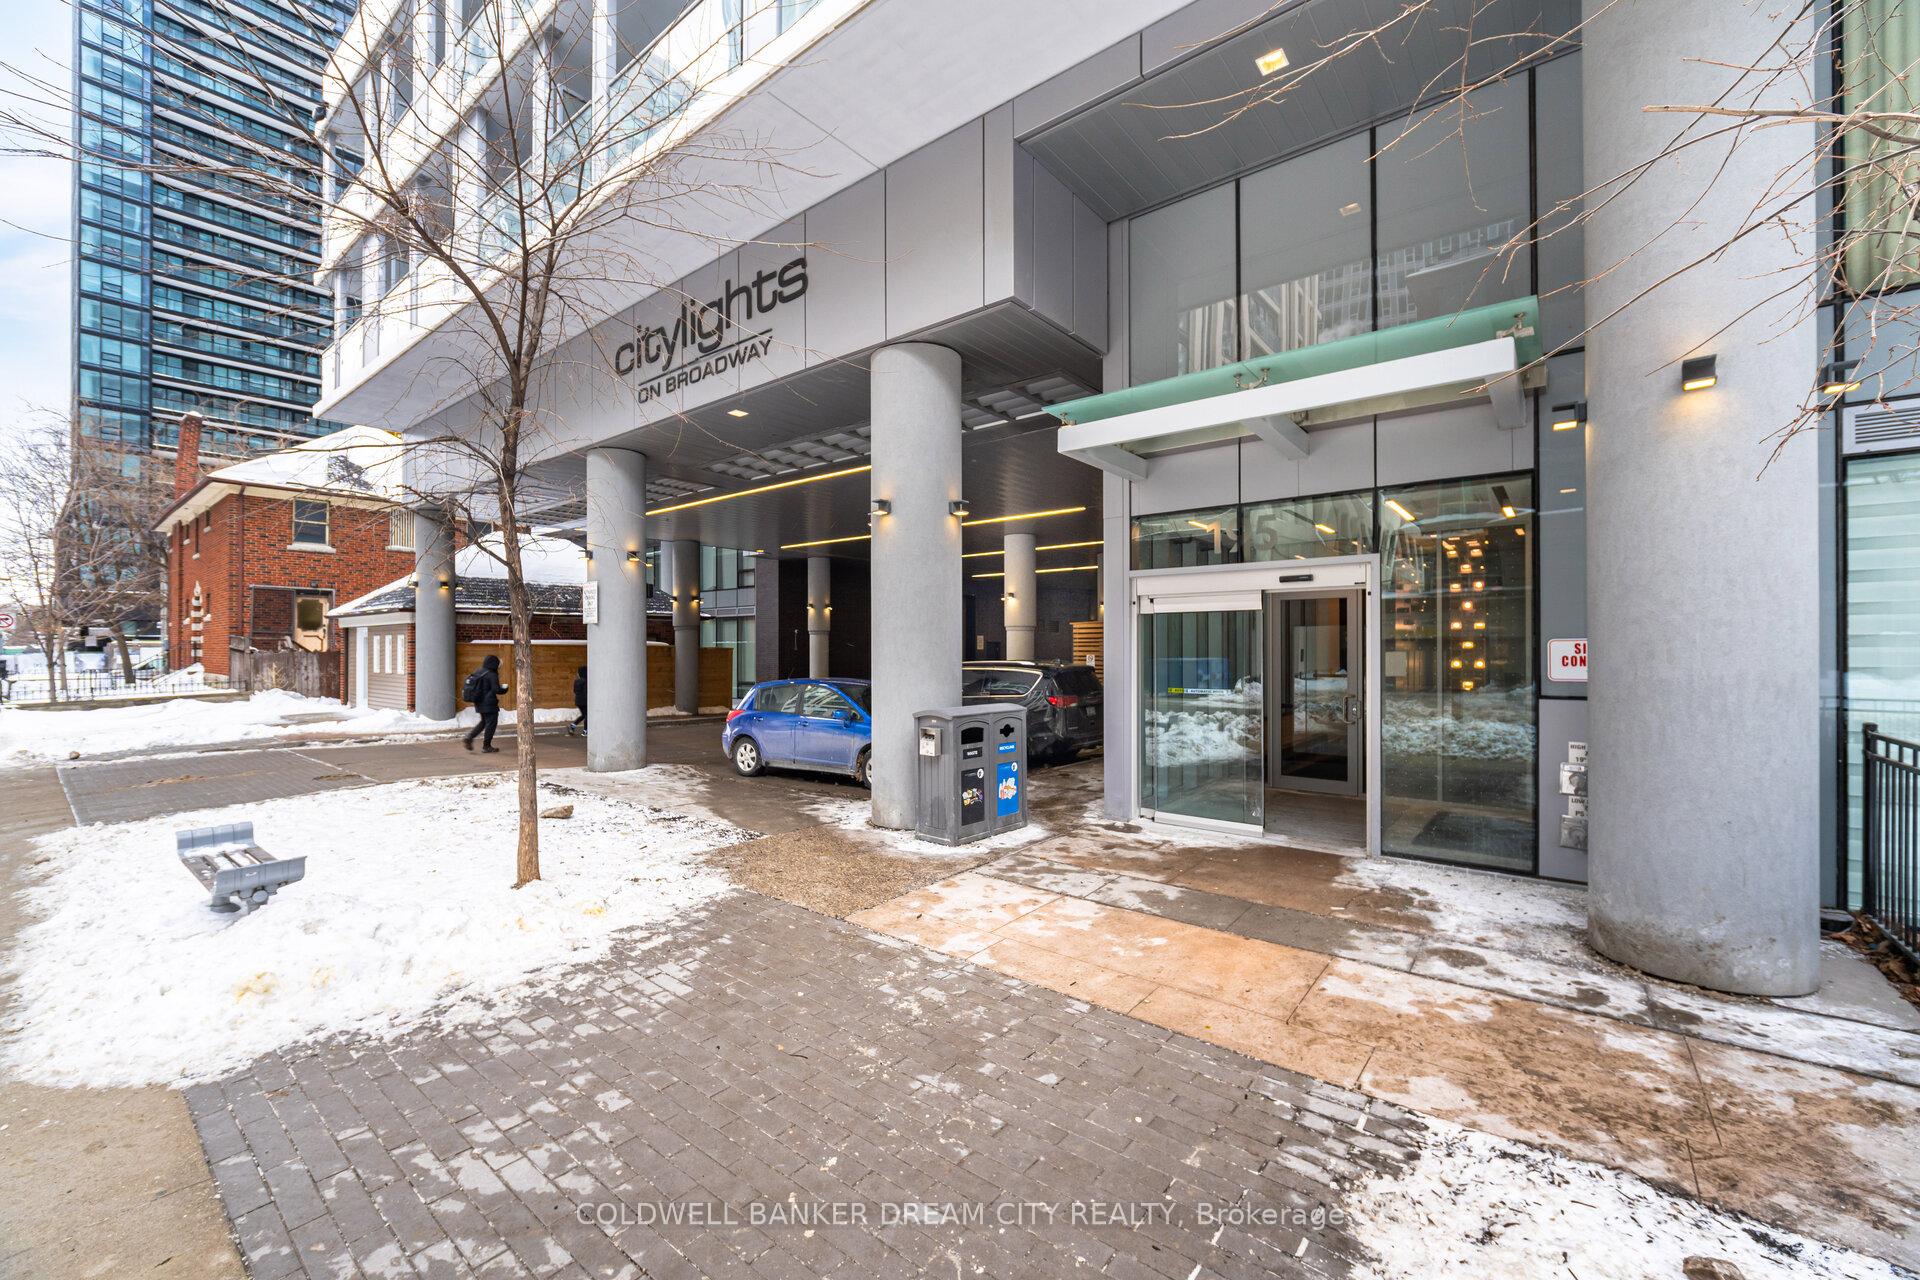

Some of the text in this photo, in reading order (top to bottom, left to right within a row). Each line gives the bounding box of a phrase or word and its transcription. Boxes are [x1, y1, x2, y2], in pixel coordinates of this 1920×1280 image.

[615, 257, 808, 375] citylights
[638, 336, 773, 404] ON BROADWAY
